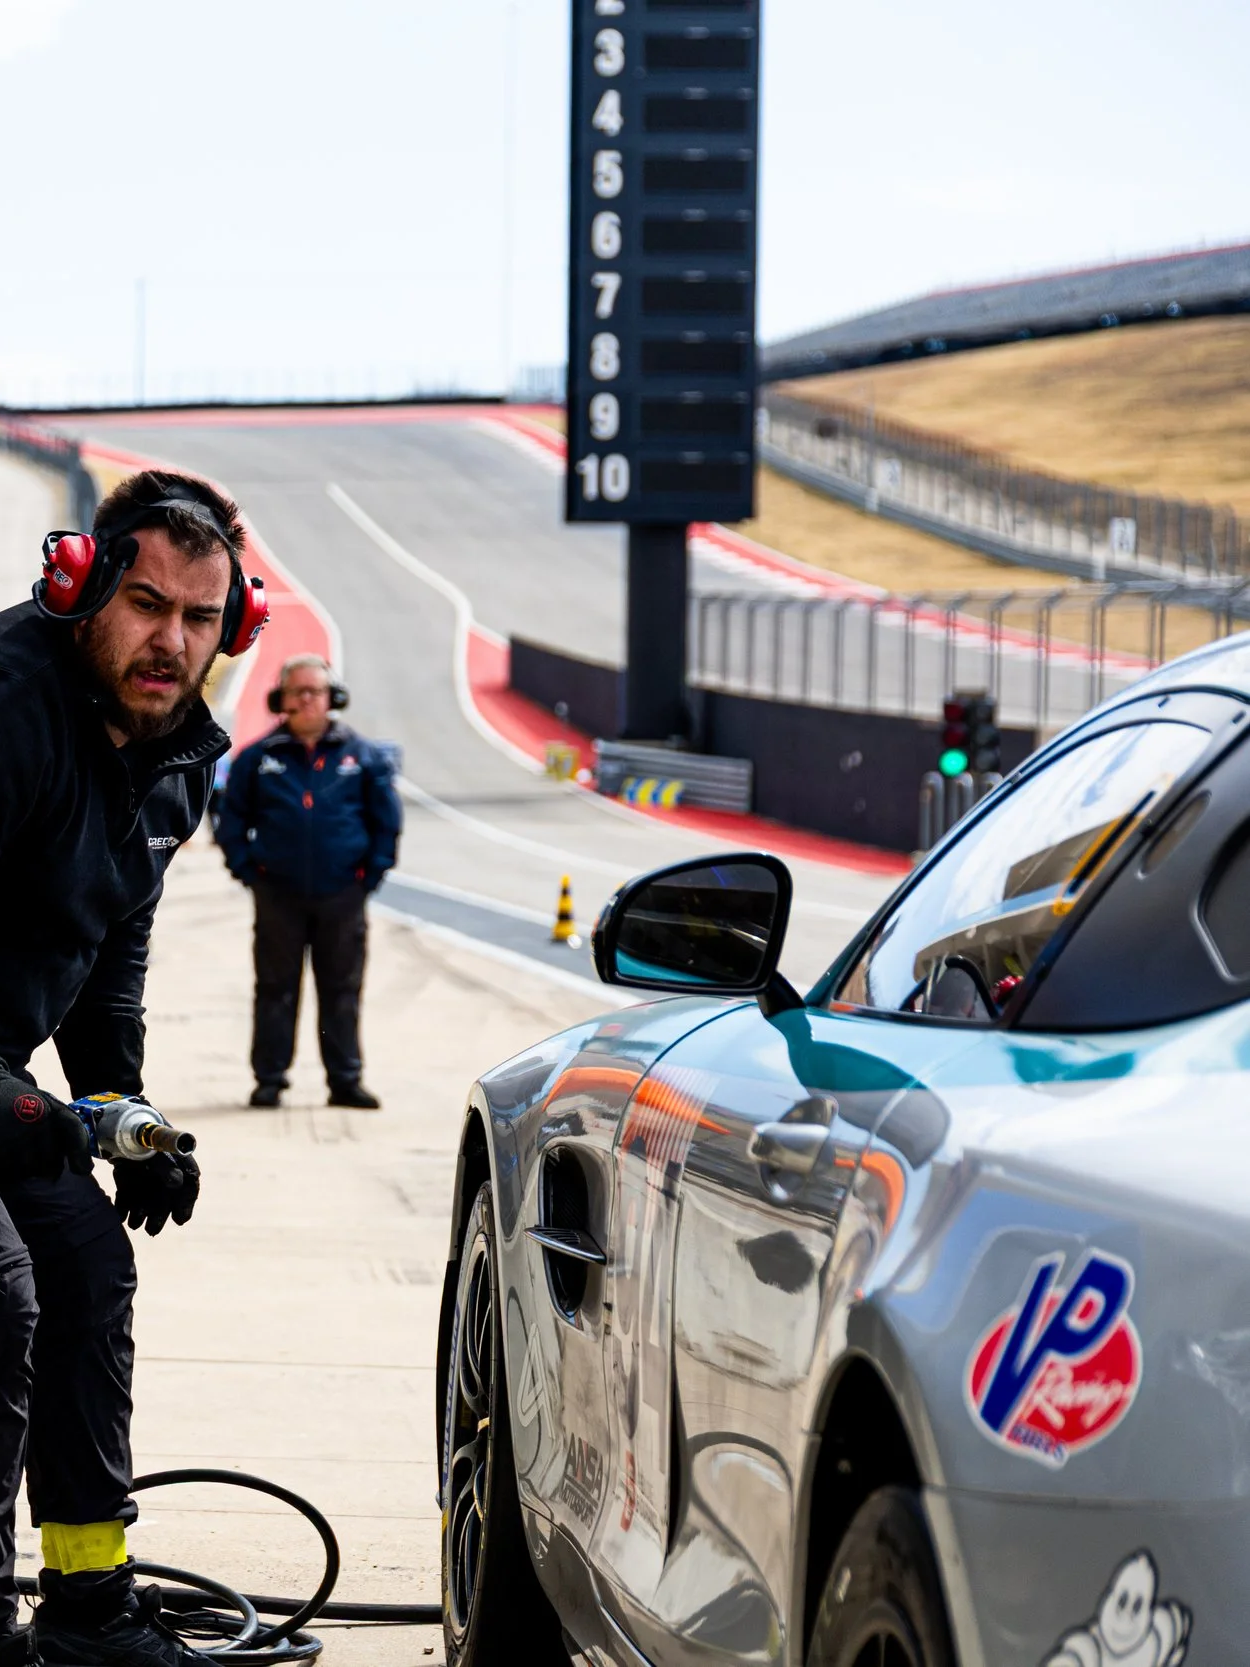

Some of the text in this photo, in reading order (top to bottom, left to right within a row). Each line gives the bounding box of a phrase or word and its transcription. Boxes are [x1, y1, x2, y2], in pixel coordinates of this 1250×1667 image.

[594, 28, 625, 76] 3
[592, 89, 623, 136] 4
[592, 150, 623, 197] 5
[591, 211, 621, 258] 6
[591, 272, 621, 318] 7
[590, 332, 620, 380] 8
[590, 393, 620, 439] 9
[577, 454, 630, 501] 10
[980, 1258, 1126, 1433] VP
[564, 1432, 603, 1501] ANSA
